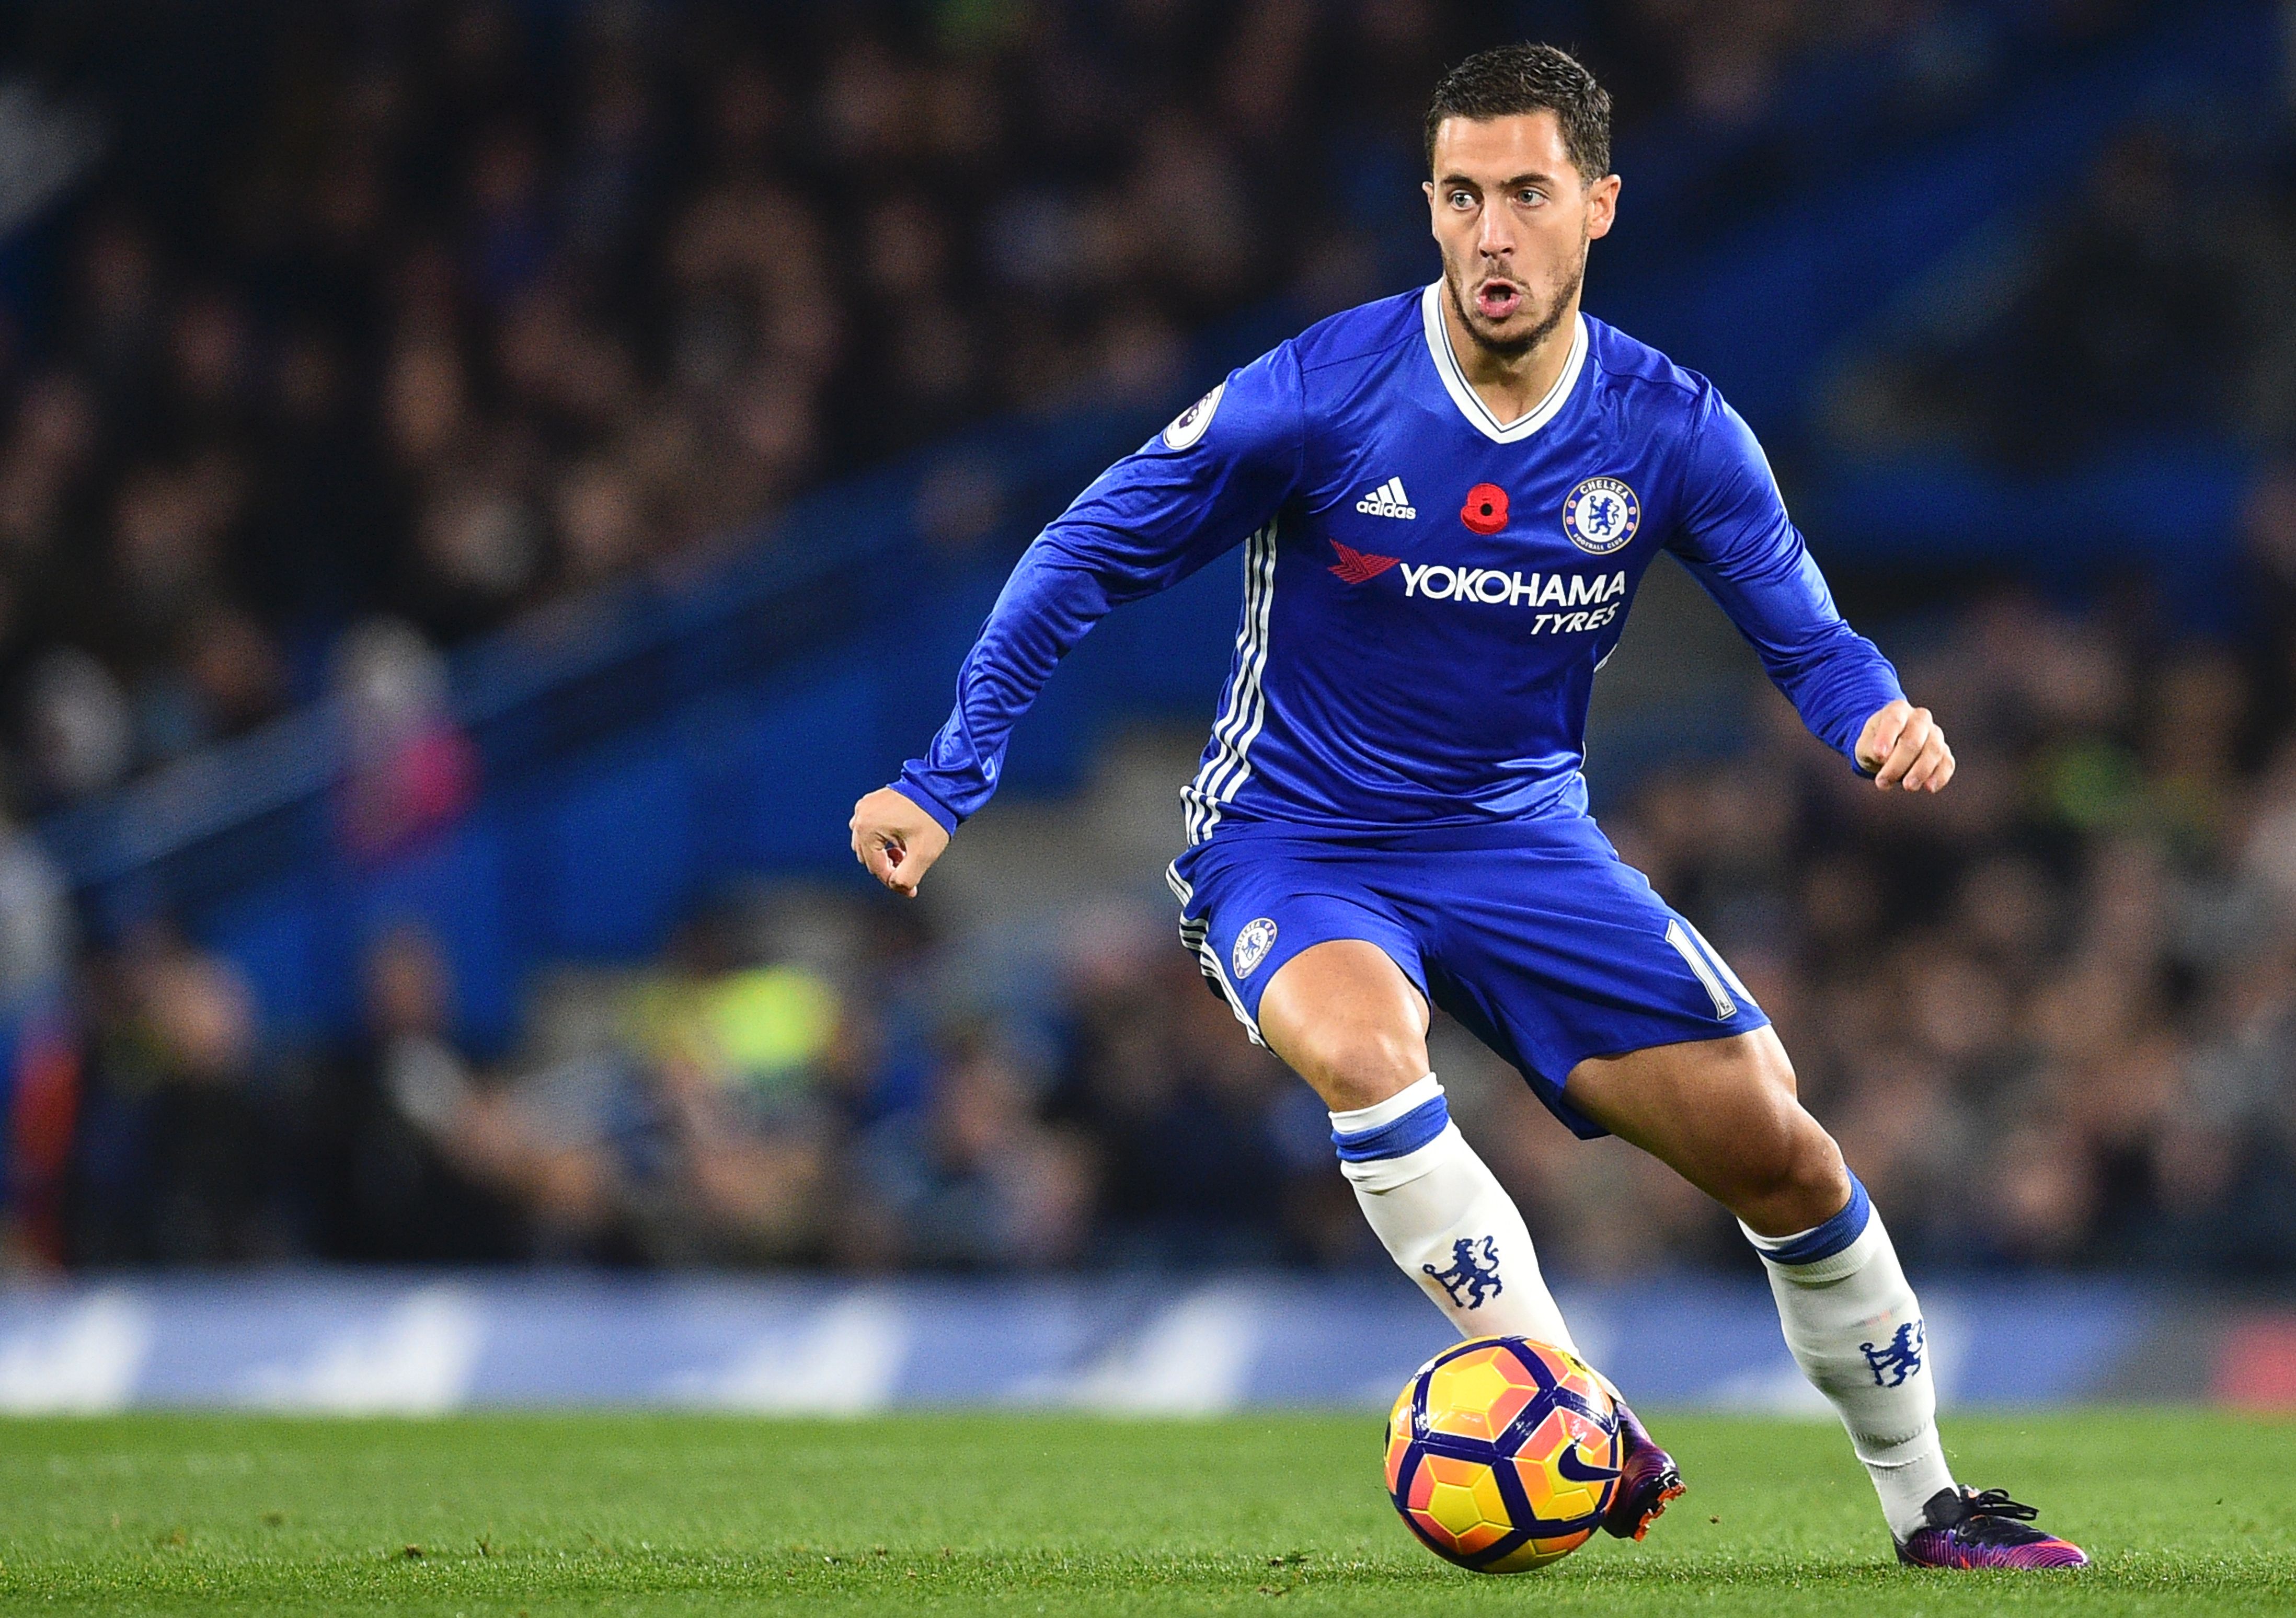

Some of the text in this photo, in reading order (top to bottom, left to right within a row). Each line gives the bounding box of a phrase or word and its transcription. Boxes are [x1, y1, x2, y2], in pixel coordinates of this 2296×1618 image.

[1580, 480, 1629, 499] CHELSEA
[1356, 500, 1416, 519] adidas
[1573, 533, 1623, 550] FOOTBALL CLUB
[1400, 563, 1625, 607] YOKOHAMA
[1531, 602, 1620, 634] TYRES
[1665, 918, 1759, 1021] 1
